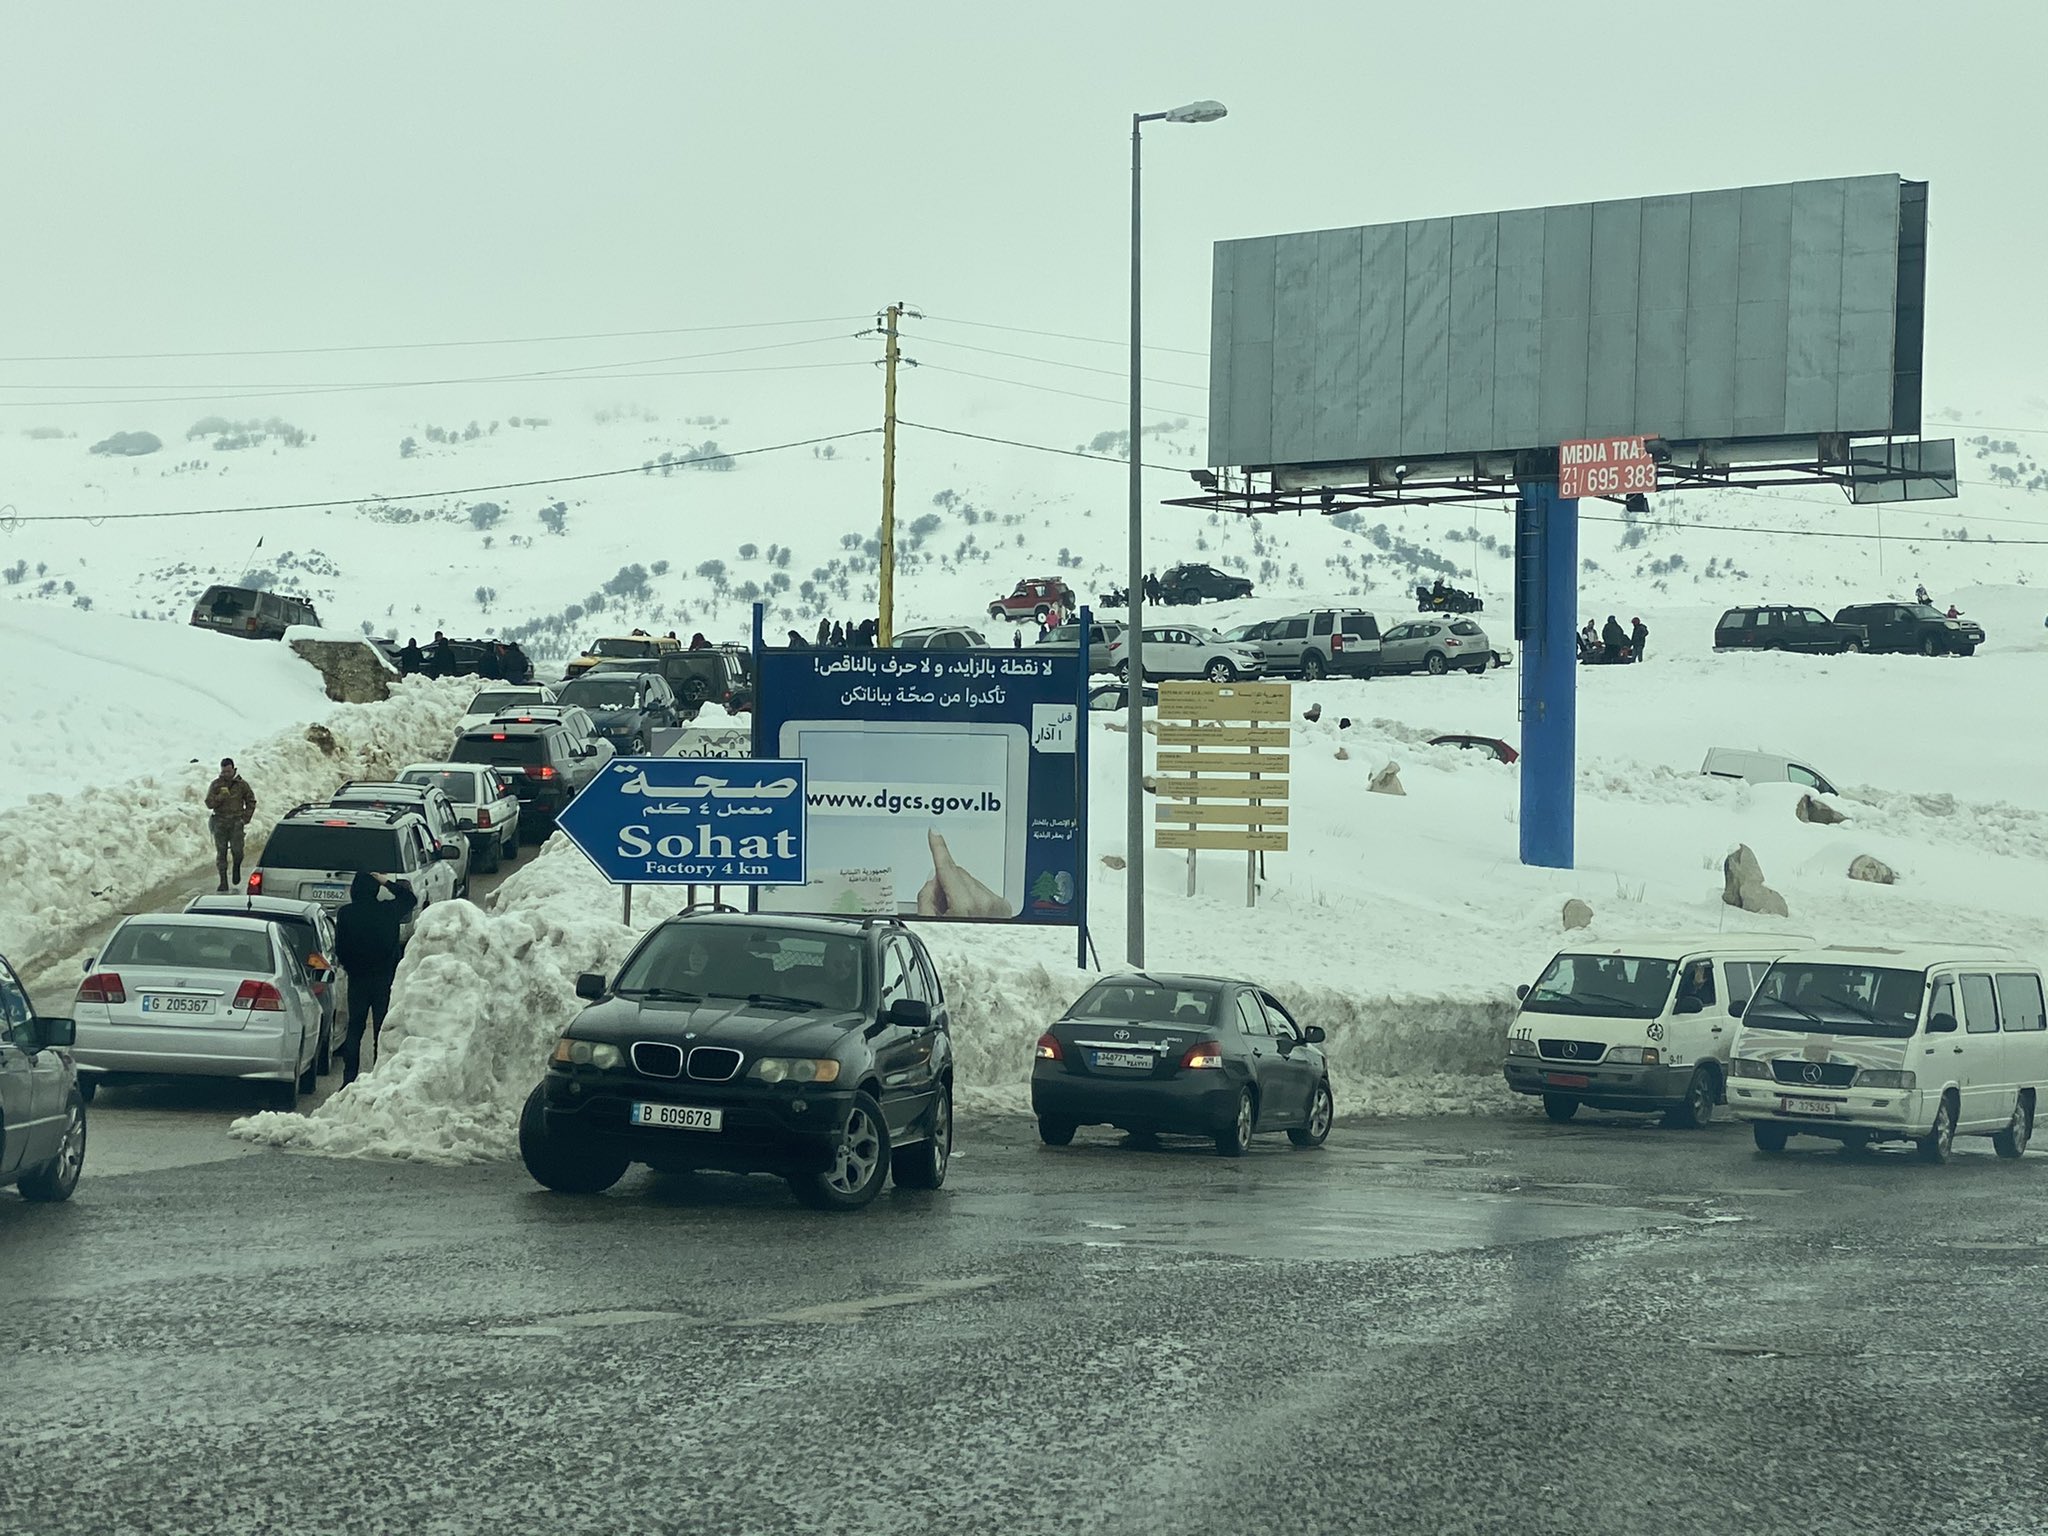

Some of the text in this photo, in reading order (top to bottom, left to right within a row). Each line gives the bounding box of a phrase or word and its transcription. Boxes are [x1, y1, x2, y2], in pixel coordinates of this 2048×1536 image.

[1562, 442, 1608, 465] MEDIA
[1563, 466, 1577, 481] 71
[1624, 463, 1656, 489] 383
[1562, 482, 1577, 495] 01
[814, 654, 1053, 678] لا نقطة بالزايد، و لا حرف بالناقص!
[840, 685, 892, 706] بياناتكن
[939, 691, 961, 707] من
[965, 684, 1006, 708] تأكدوا
[1057, 711, 1073, 723] قبل
[1034, 722, 1057, 744] آذار
[613, 764, 798, 799] صحة
[642, 802, 691, 817] كلم
[716, 803, 774, 818] معمل
[806, 788, 1001, 815] www.dgcs.gov.lb
[617, 824, 797, 860] Sohat
[645, 861, 769, 878] Factory 4 km
[152, 998, 209, 1012] G 205367
[643, 1106, 712, 1126] B 609678
